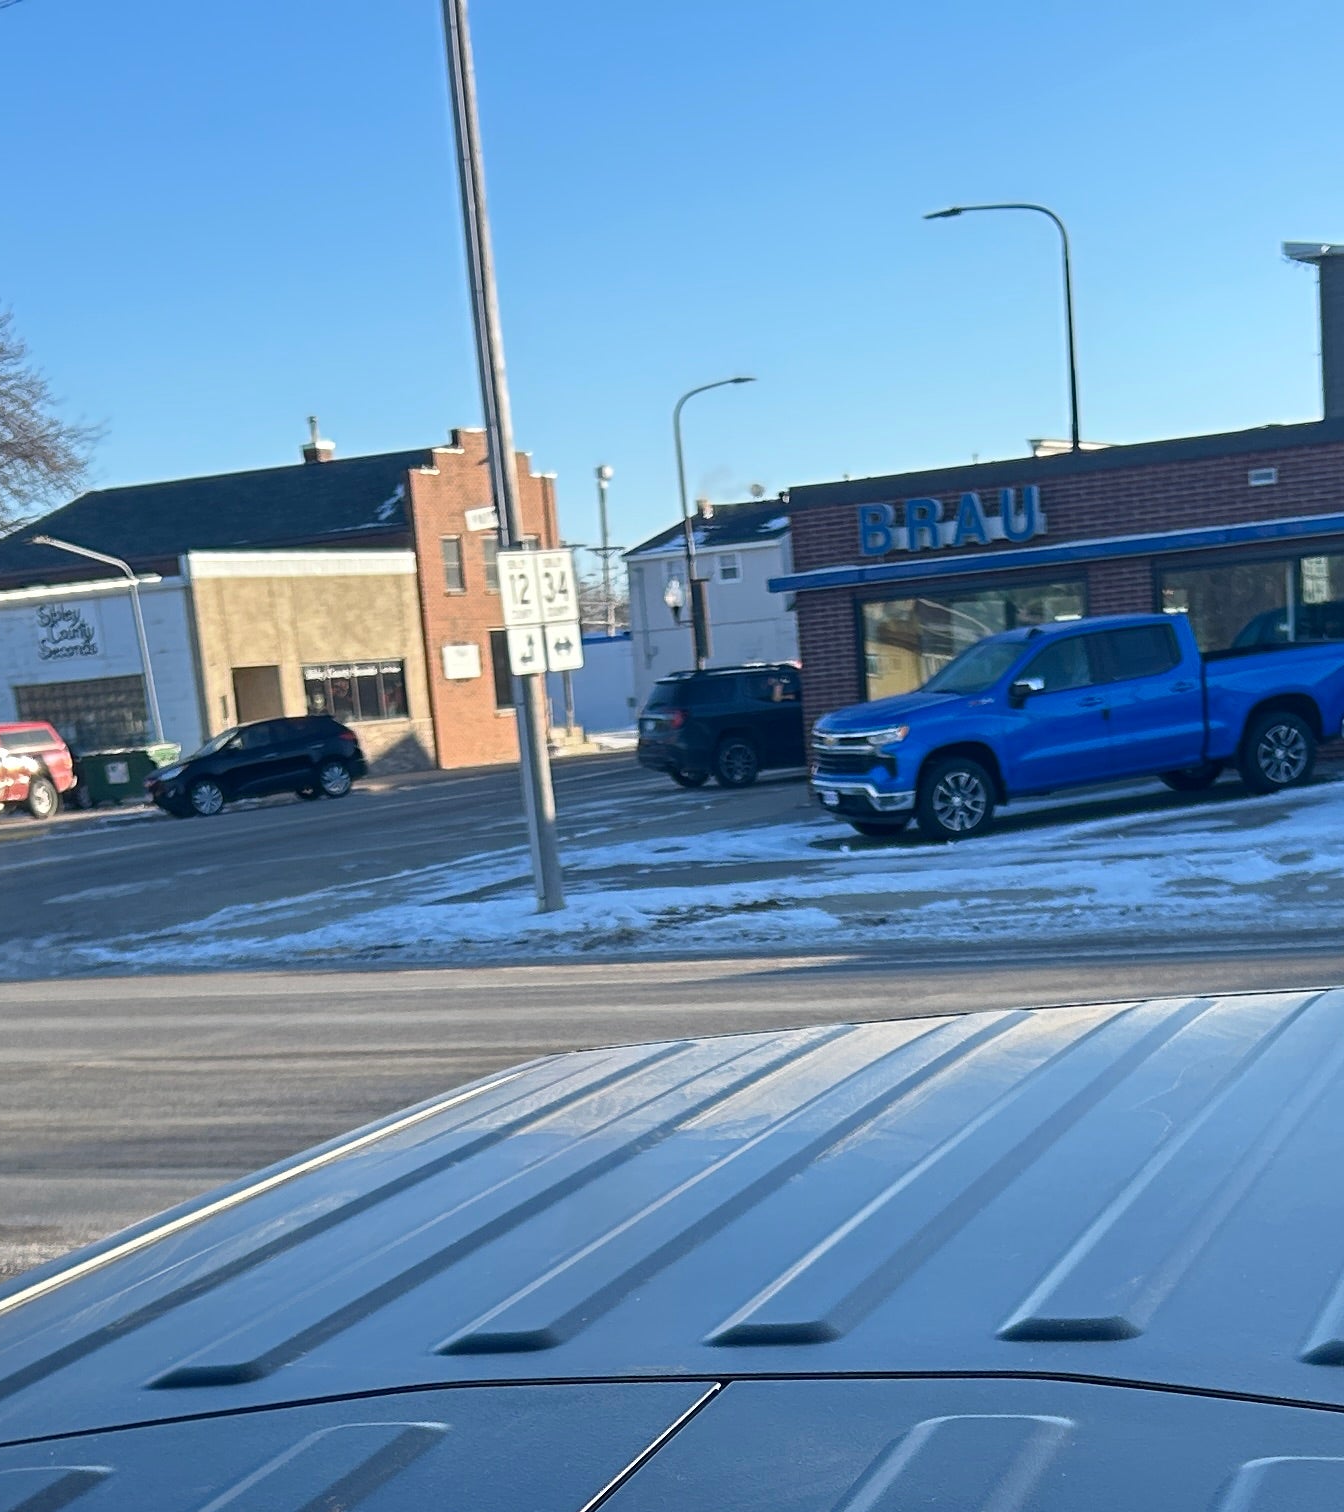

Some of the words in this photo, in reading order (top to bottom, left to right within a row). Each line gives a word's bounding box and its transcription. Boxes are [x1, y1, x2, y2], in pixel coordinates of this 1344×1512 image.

[859, 485, 1039, 556] BRAU
[509, 573, 531, 605] 12
[543, 570, 569, 603] 34
